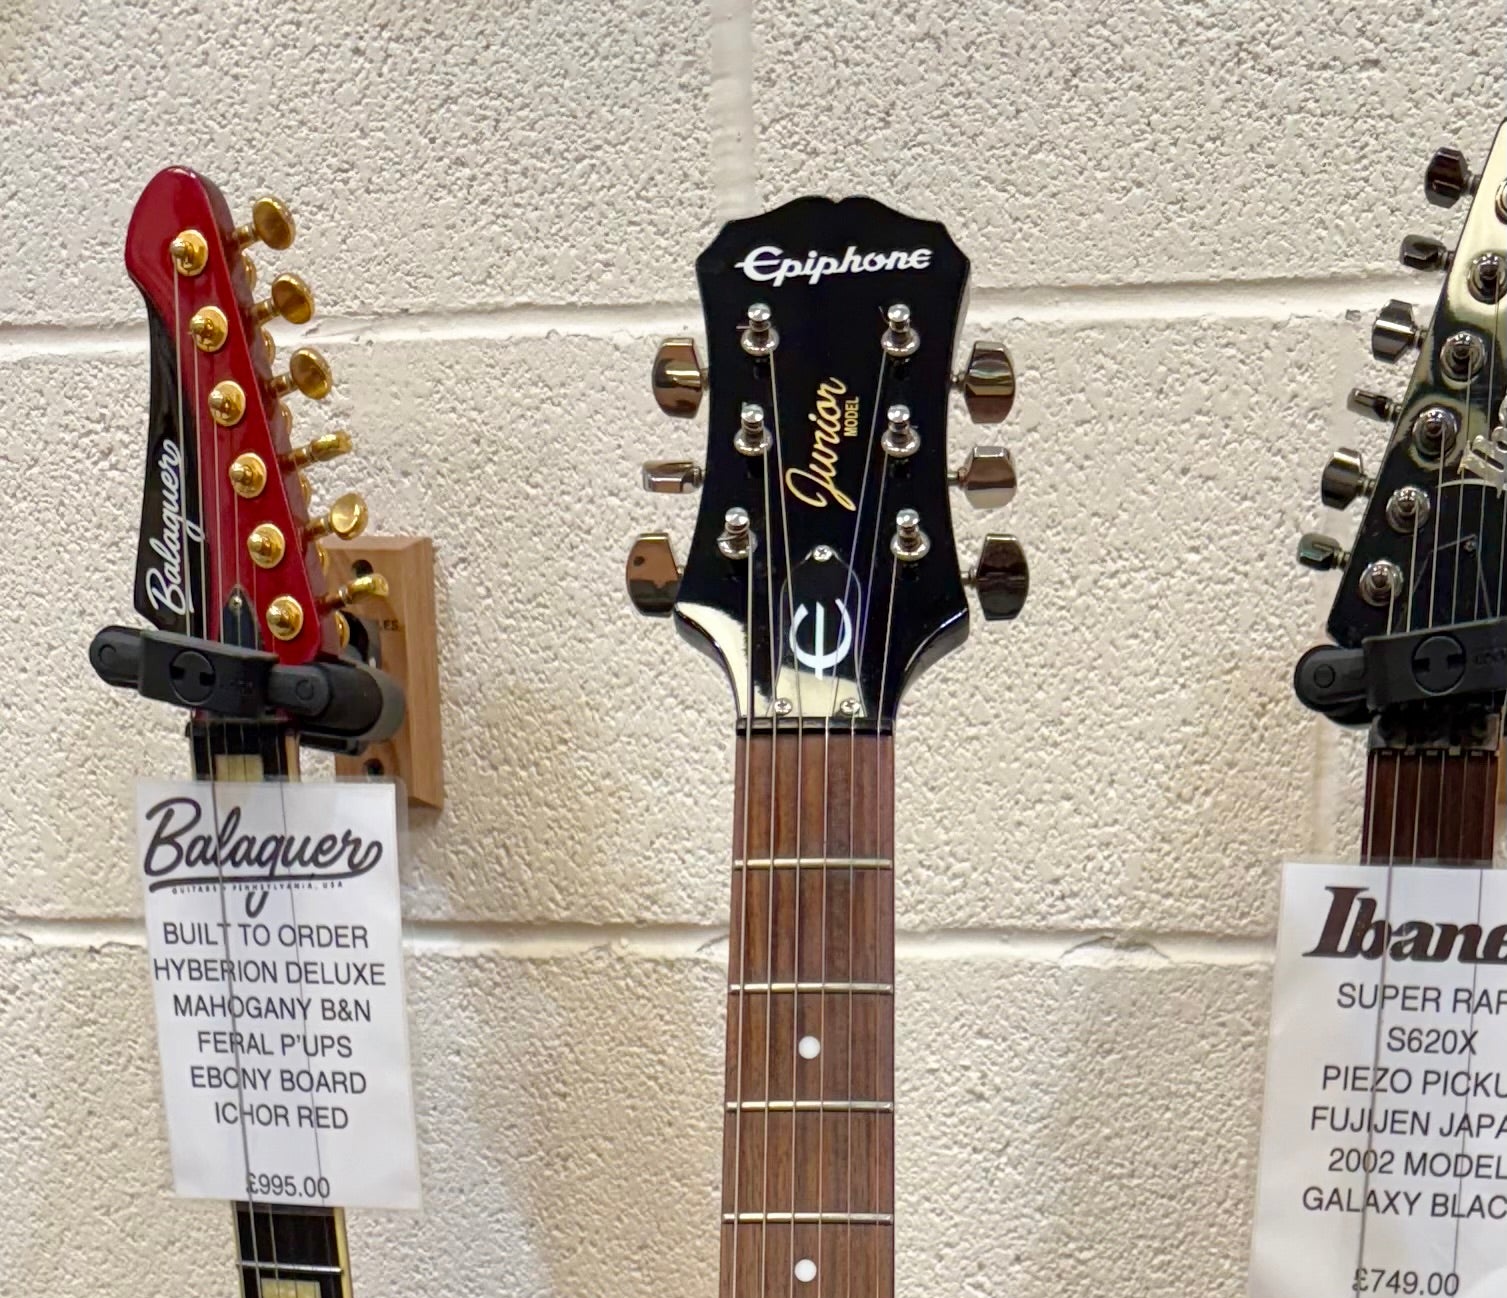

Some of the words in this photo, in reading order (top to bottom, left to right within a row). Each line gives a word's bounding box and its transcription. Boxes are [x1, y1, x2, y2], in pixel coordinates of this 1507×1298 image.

[734, 246, 932, 287] Epiphone
[844, 396, 860, 437] MODEL
[785, 377, 856, 511] Junior
[146, 439, 205, 615] Balaguer
[144, 797, 383, 918] Balaguer
[163, 922, 231, 945] BUILT
[238, 923, 270, 946] TO
[278, 924, 369, 949] ORDER
[153, 958, 277, 984] HYBERION
[286, 961, 386, 986] DELUXE
[173, 994, 311, 1021] MAHOGANY
[321, 998, 371, 1022] B&N
[1337, 983, 1441, 1013] SUPER
[197, 1031, 274, 1055] FERAL
[1387, 1027, 1479, 1055] S620X
[190, 1066, 271, 1091] EBONY
[280, 1069, 366, 1094] BOARD
[1322, 1065, 1412, 1094] PIEZO
[215, 1102, 290, 1127] ICHOR
[297, 1106, 349, 1129] RED
[1328, 1148, 1395, 1174] 2002
[1403, 1151, 1507, 1180] MODEL
[246, 1172, 330, 1198] £995.00
[1302, 1186, 1422, 1215] GALAXY
[1352, 1268, 1460, 1297] £749.00
